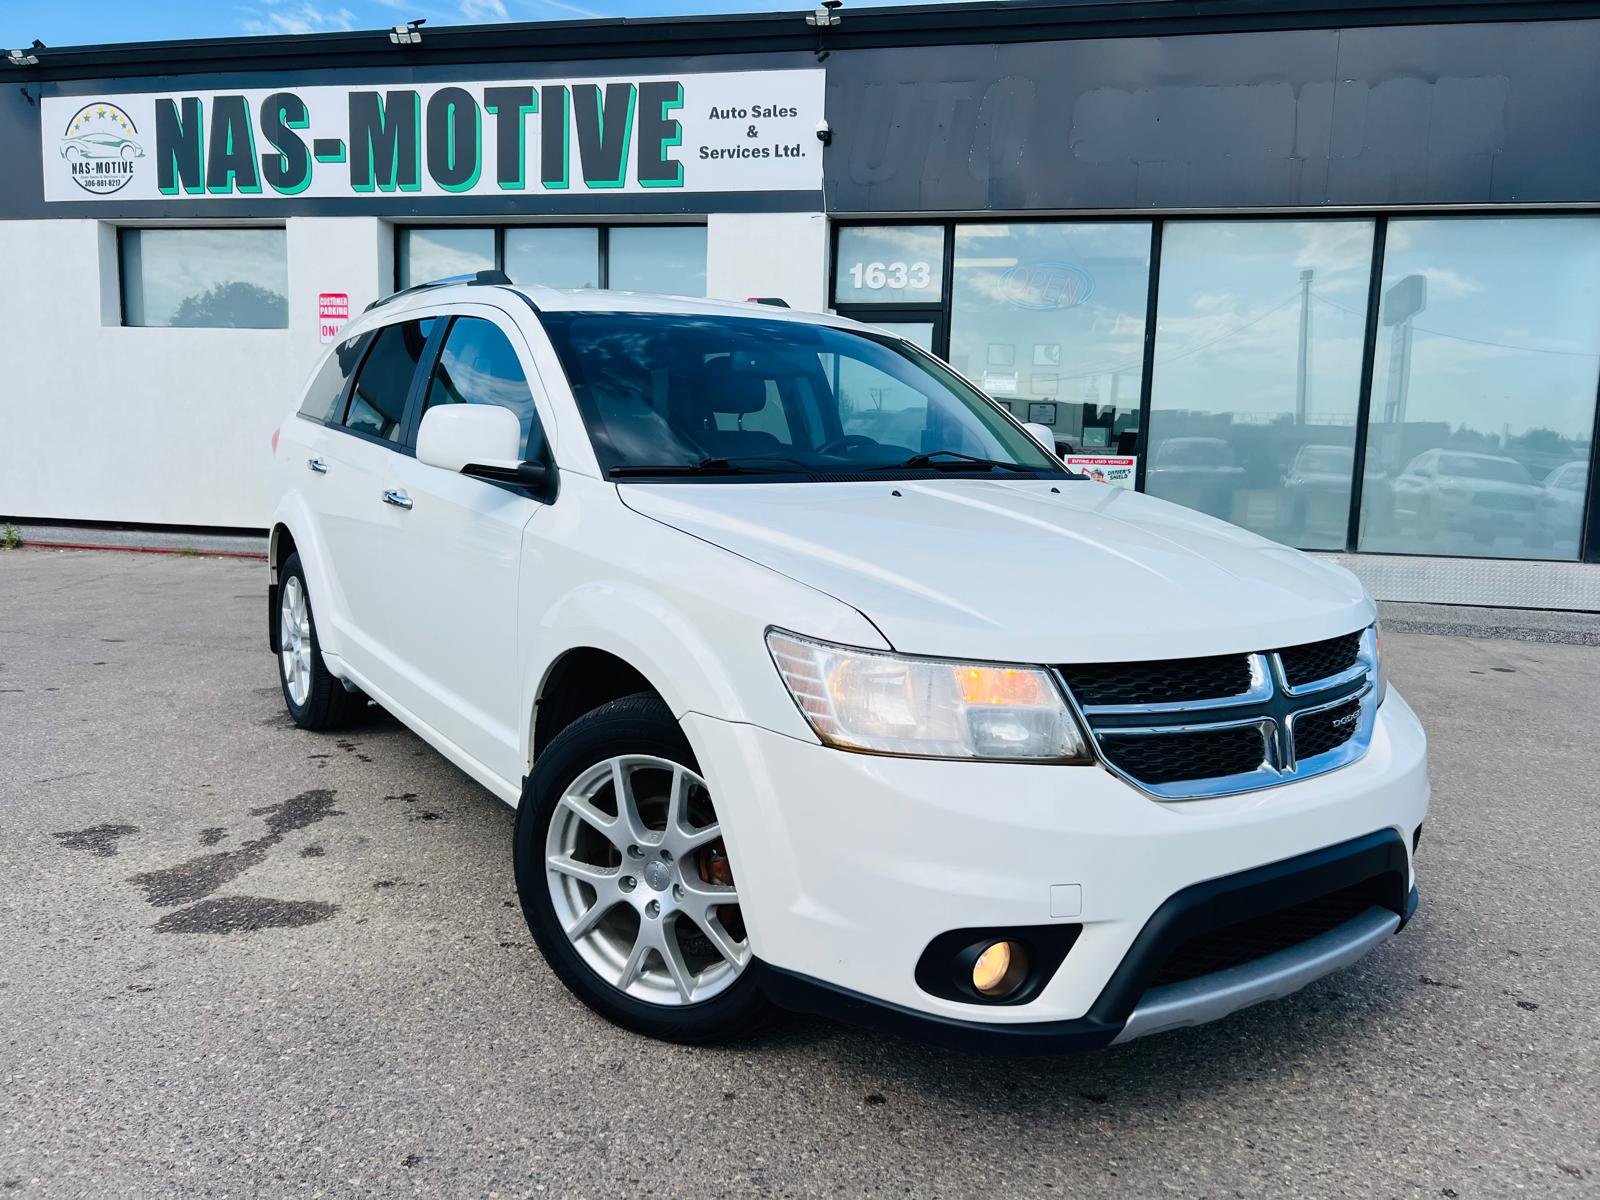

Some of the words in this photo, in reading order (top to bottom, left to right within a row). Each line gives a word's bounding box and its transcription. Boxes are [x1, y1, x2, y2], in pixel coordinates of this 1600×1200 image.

[709, 106, 747, 120] Auto
[751, 104, 798, 118] Sales
[155, 81, 684, 195] NAS-MOTIVE
[746, 124, 759, 138] &
[699, 145, 770, 159] Services
[774, 143, 806, 158] Ltd.
[71, 161, 134, 175] NAS-MOTIVE
[849, 262, 930, 289] 1633
[320, 306, 348, 315] PARKING
[322, 325, 338, 336] ON
[1332, 709, 1361, 728] DODG
